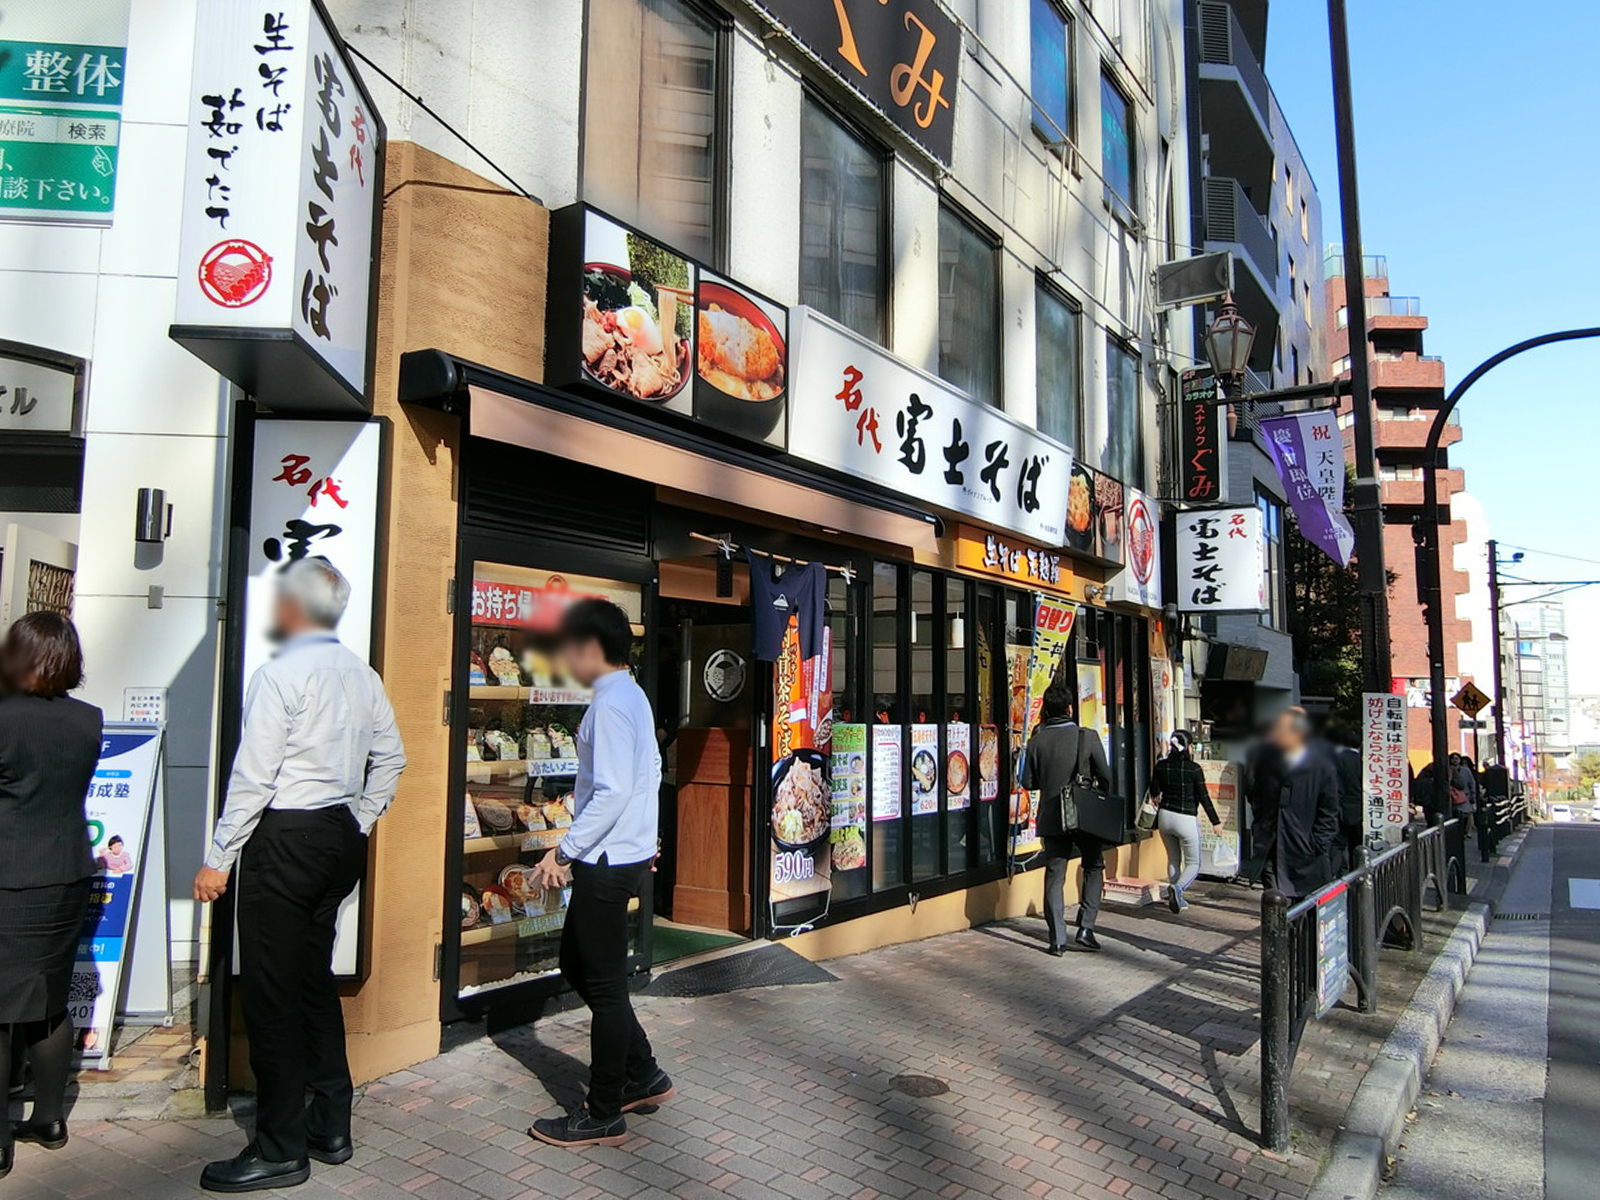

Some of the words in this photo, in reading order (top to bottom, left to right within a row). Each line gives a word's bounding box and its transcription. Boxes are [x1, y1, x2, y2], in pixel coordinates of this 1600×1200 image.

[23, 50, 122, 96] 整体
[254, 12, 293, 132] 生そば
[68, 123, 107, 141] 検索
[201, 88, 245, 229] 茹でたて
[0, 177, 110, 204] 談下さい。
[835, 366, 882, 454] 名代
[896, 393, 1049, 513] 富士そば
[1194, 404, 1206, 447] スナック
[1312, 425, 1331, 441] 祝
[272, 461, 348, 515] 名代
[1191, 449, 1215, 498] くみ
[1228, 514, 1248, 539] 名代
[1189, 518, 1226, 605] 富士そば
[1386, 697, 1403, 824] 自転車は歩行者の通行の
[774, 850, 815, 884] 590円
